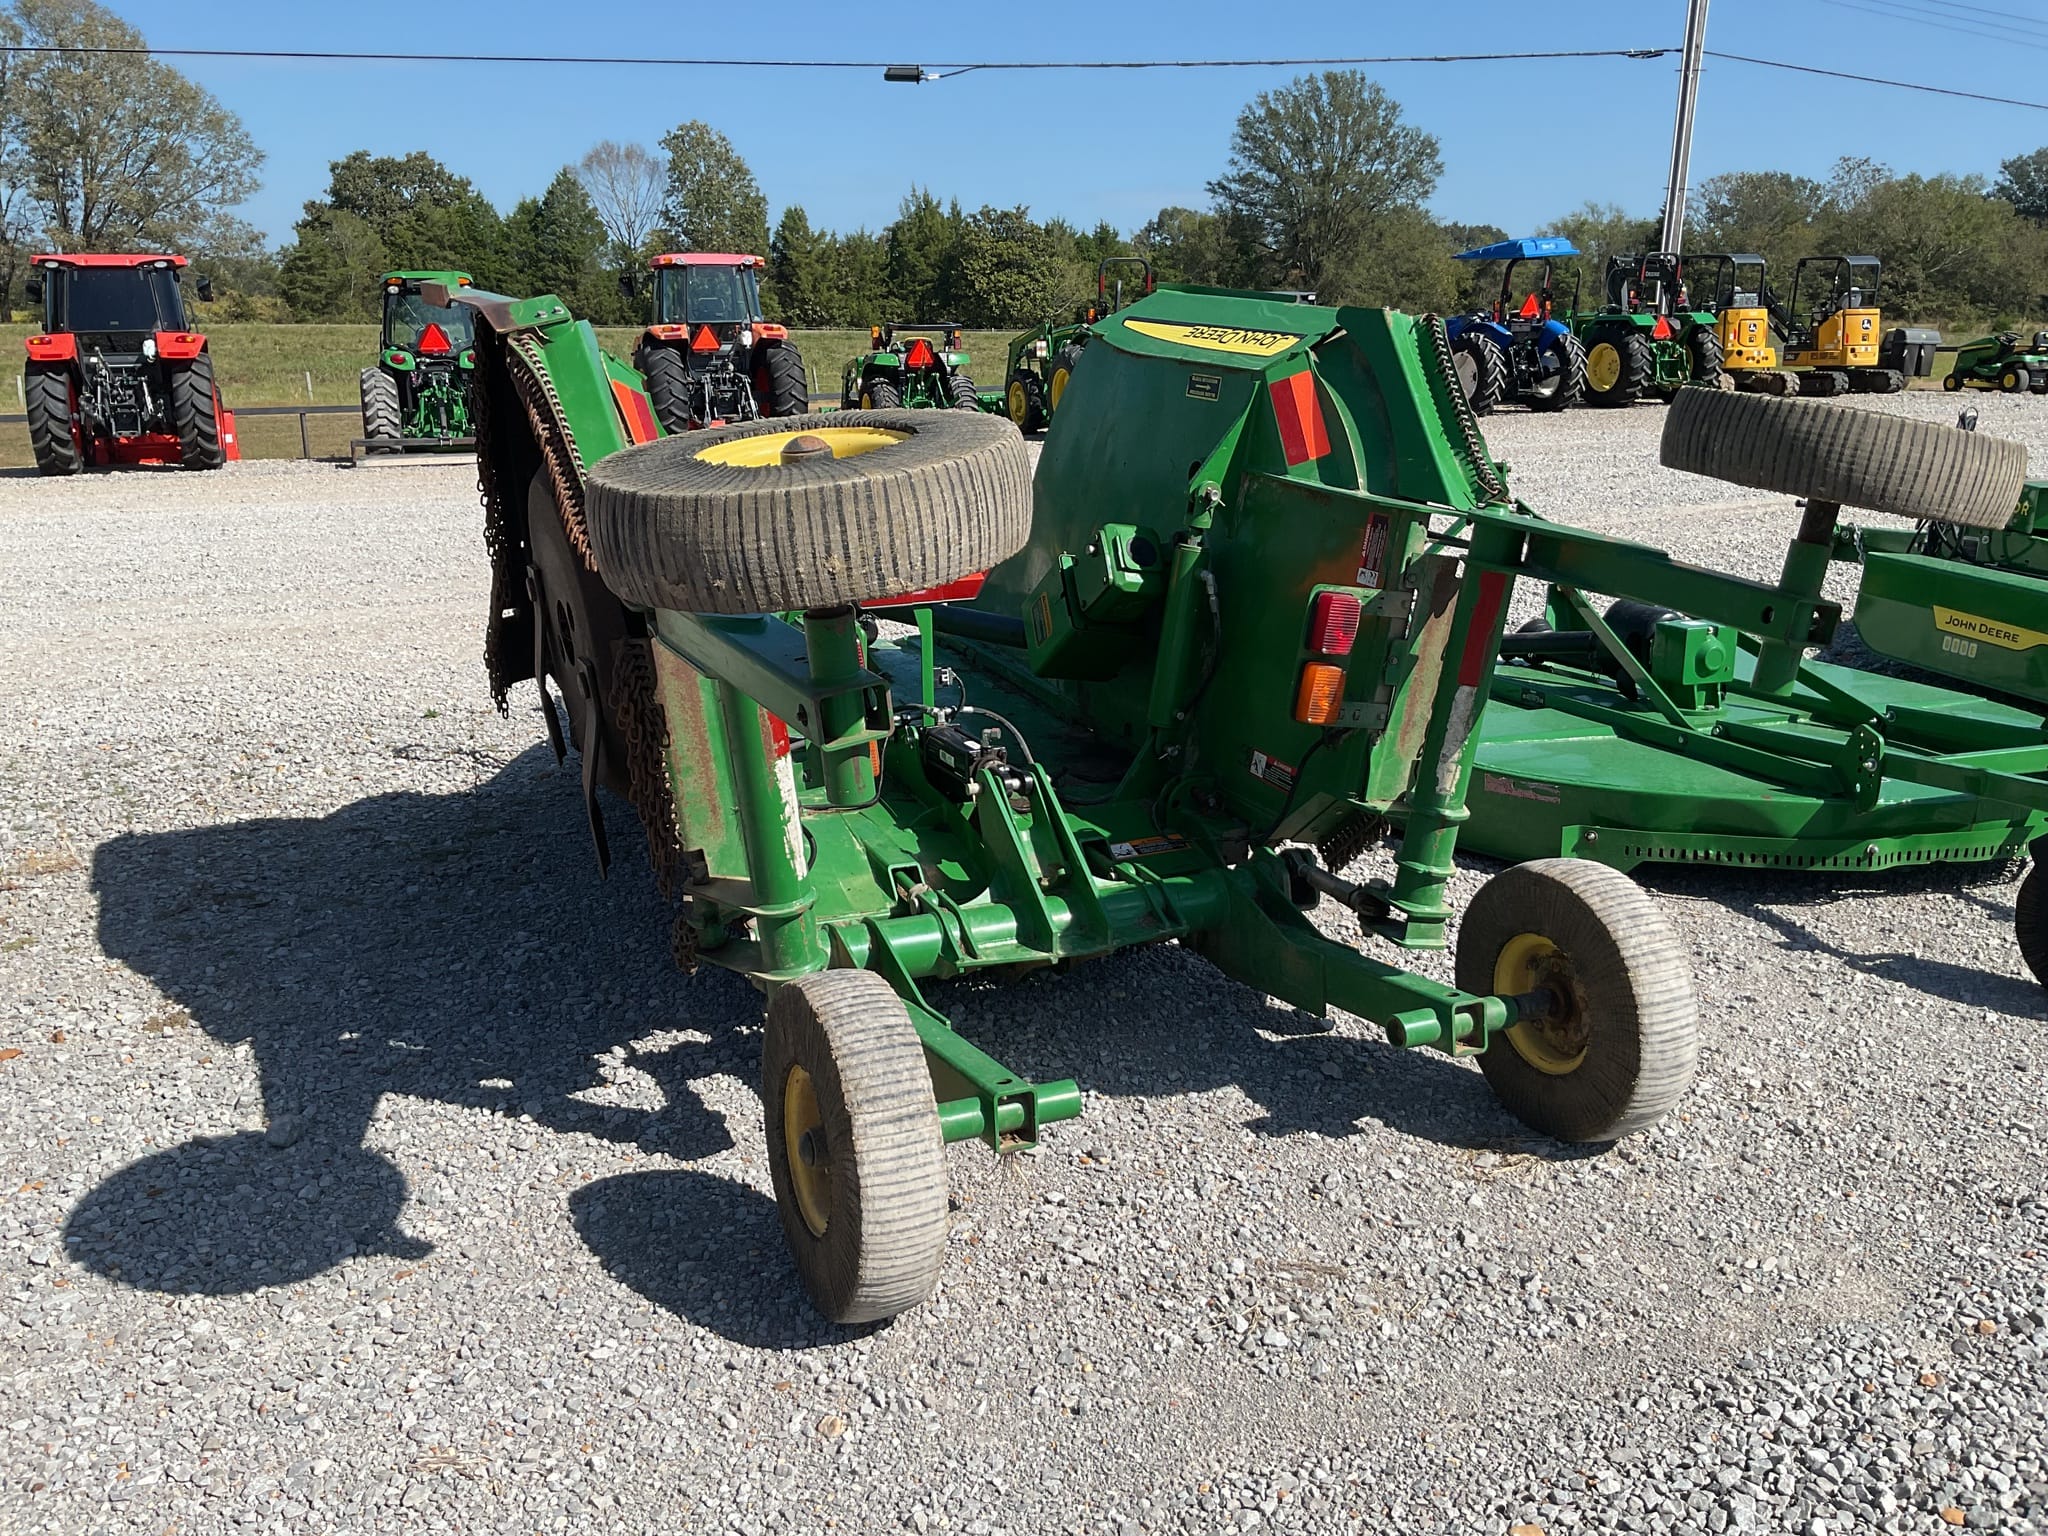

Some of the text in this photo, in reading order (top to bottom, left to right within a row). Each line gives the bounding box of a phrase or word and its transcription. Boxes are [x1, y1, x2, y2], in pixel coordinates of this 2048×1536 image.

[1183, 327, 1288, 348] JOHN DEERE
[1945, 615, 2019, 642] JOHN DEERE
